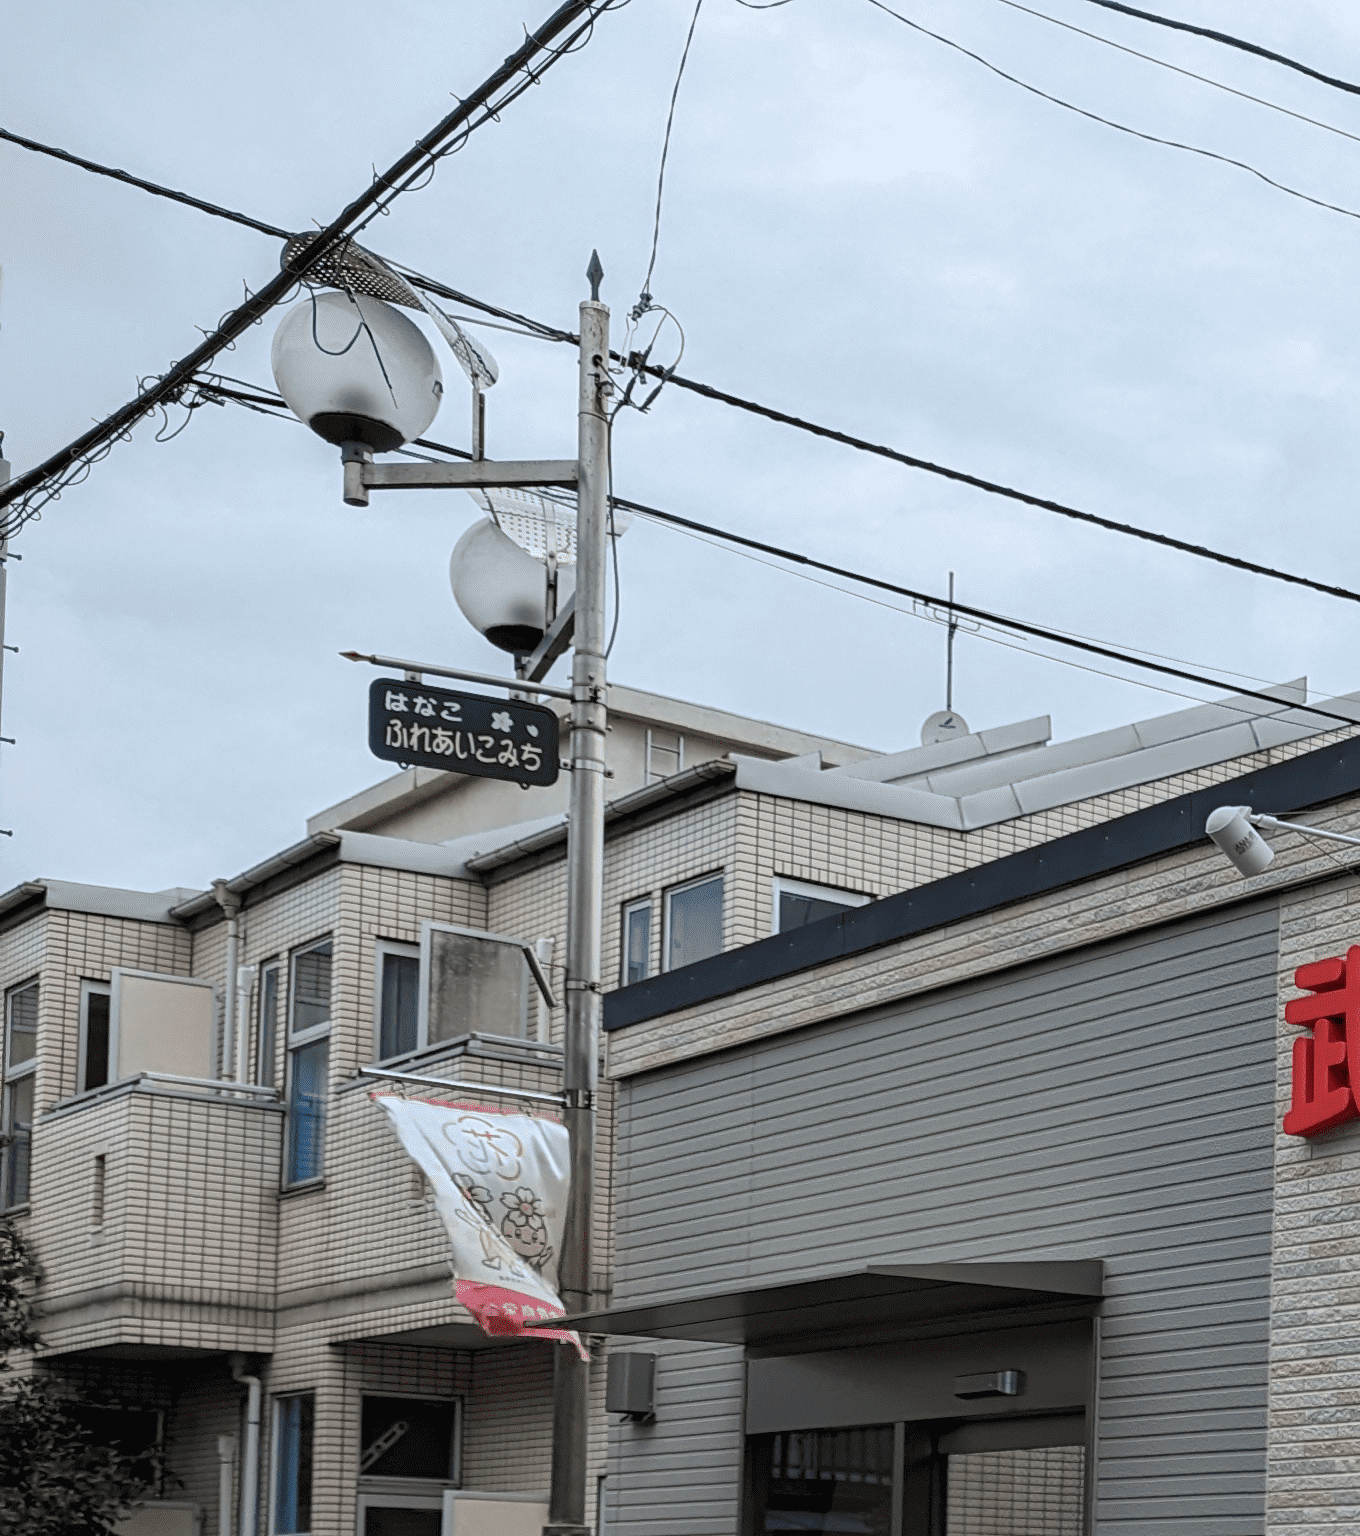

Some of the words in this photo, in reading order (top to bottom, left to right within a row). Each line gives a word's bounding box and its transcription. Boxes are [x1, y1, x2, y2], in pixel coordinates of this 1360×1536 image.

[385, 690, 463, 722] はなこ
[385, 718, 542, 772] ふれあいこみち
